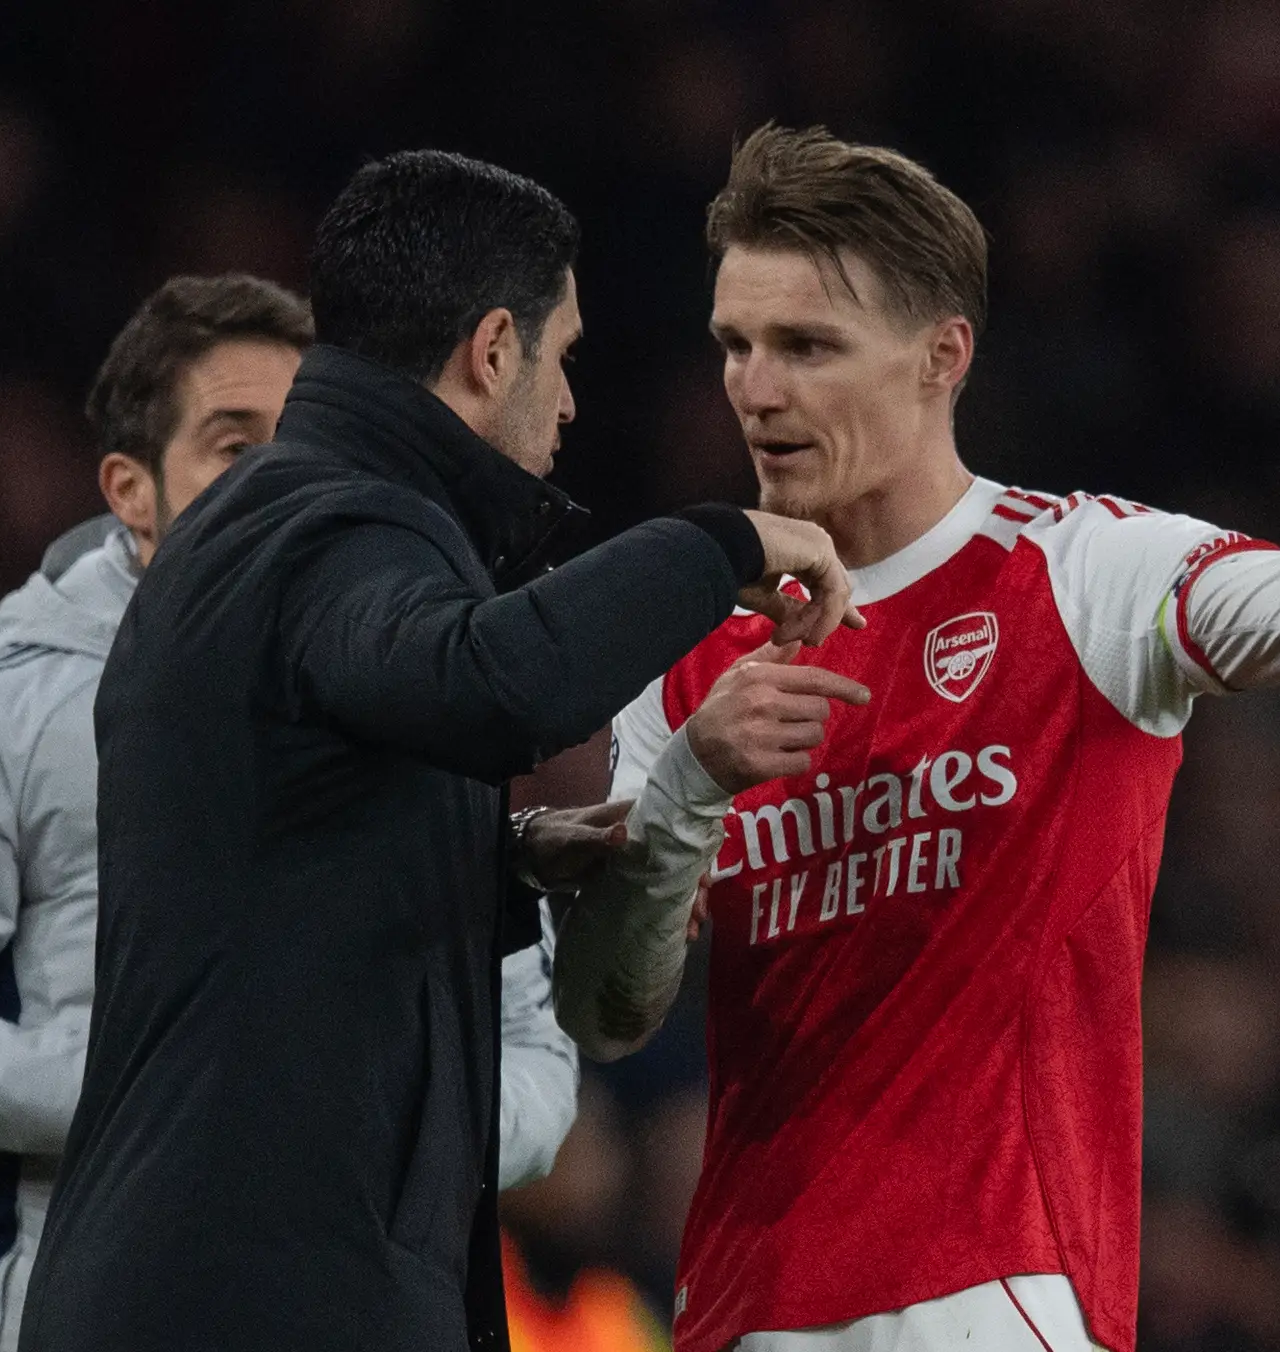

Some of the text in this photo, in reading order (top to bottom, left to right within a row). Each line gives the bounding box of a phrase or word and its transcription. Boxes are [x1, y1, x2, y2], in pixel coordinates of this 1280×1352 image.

[935, 624, 988, 652] Arsenal
[749, 828, 963, 946] FLY BETTER
